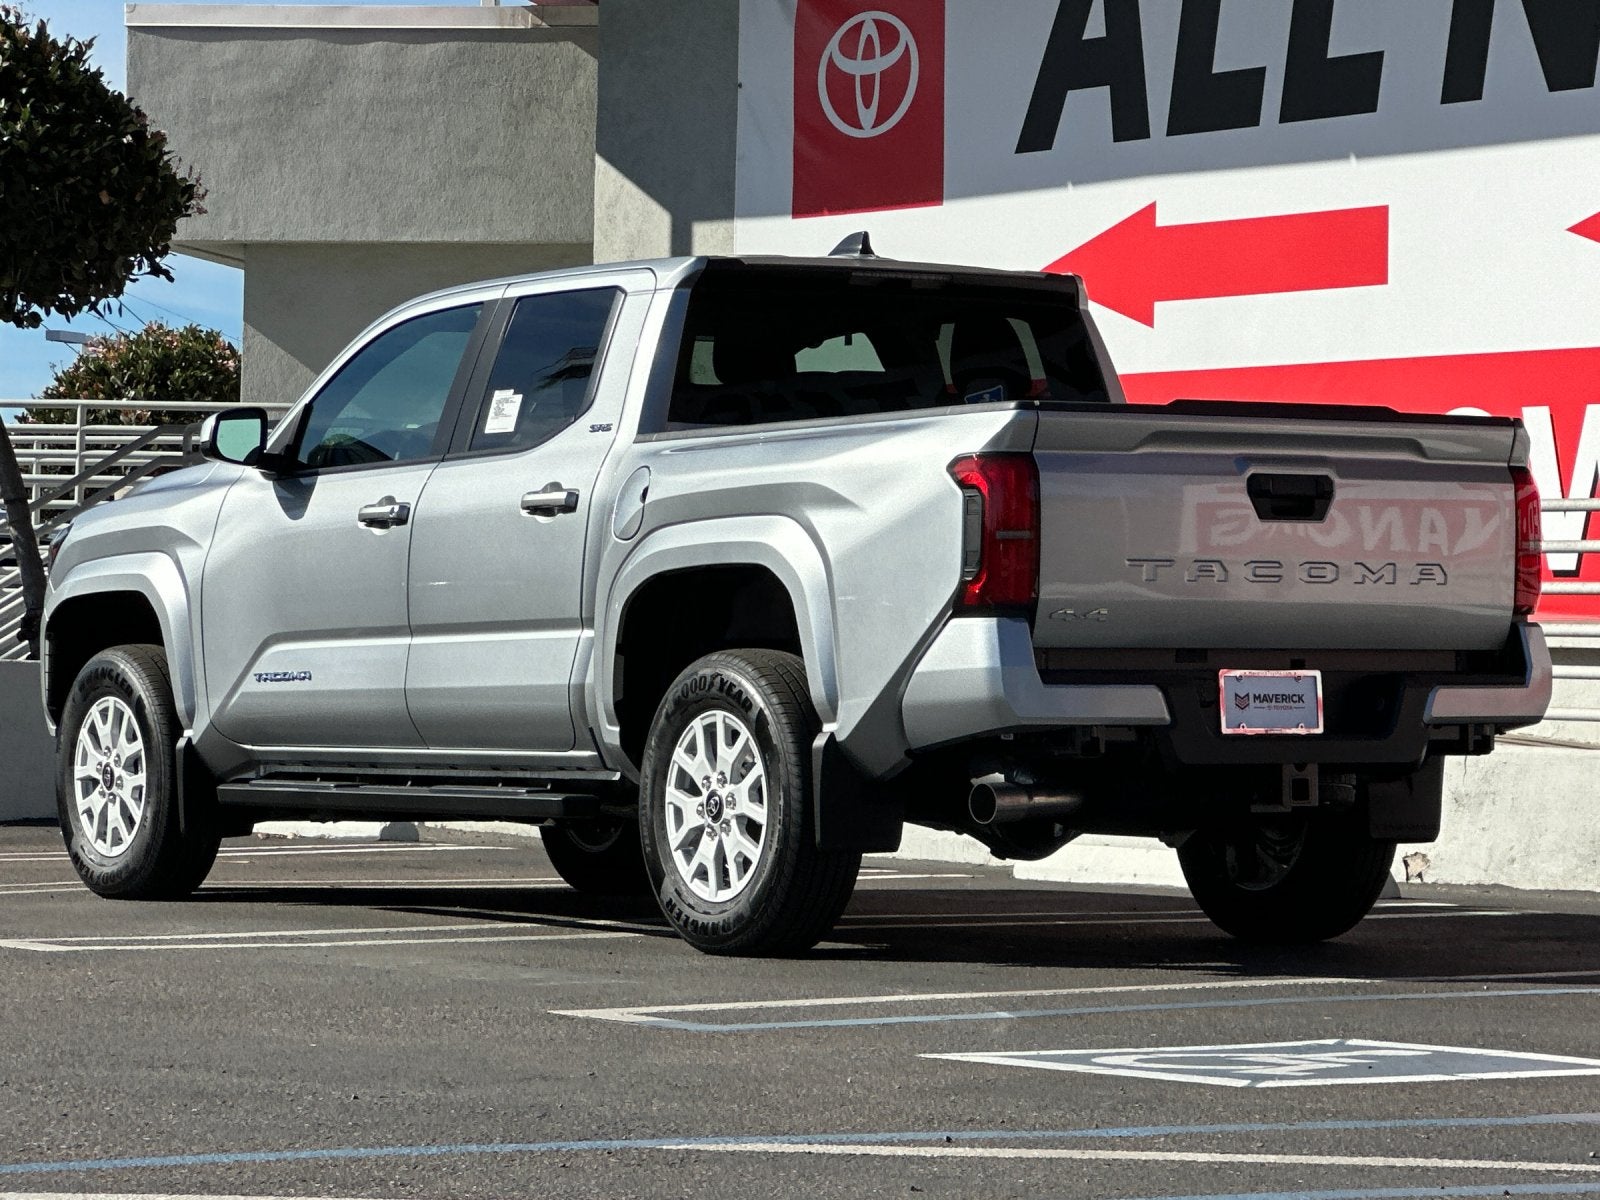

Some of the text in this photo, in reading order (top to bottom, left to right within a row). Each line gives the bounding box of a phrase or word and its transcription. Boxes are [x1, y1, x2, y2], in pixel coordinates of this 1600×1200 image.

[1015, 0, 1385, 154] ALL
[1125, 558, 1448, 586] TACOMA
[253, 671, 313, 683] TACOMA
[1253, 693, 1305, 704] MAVERICK
